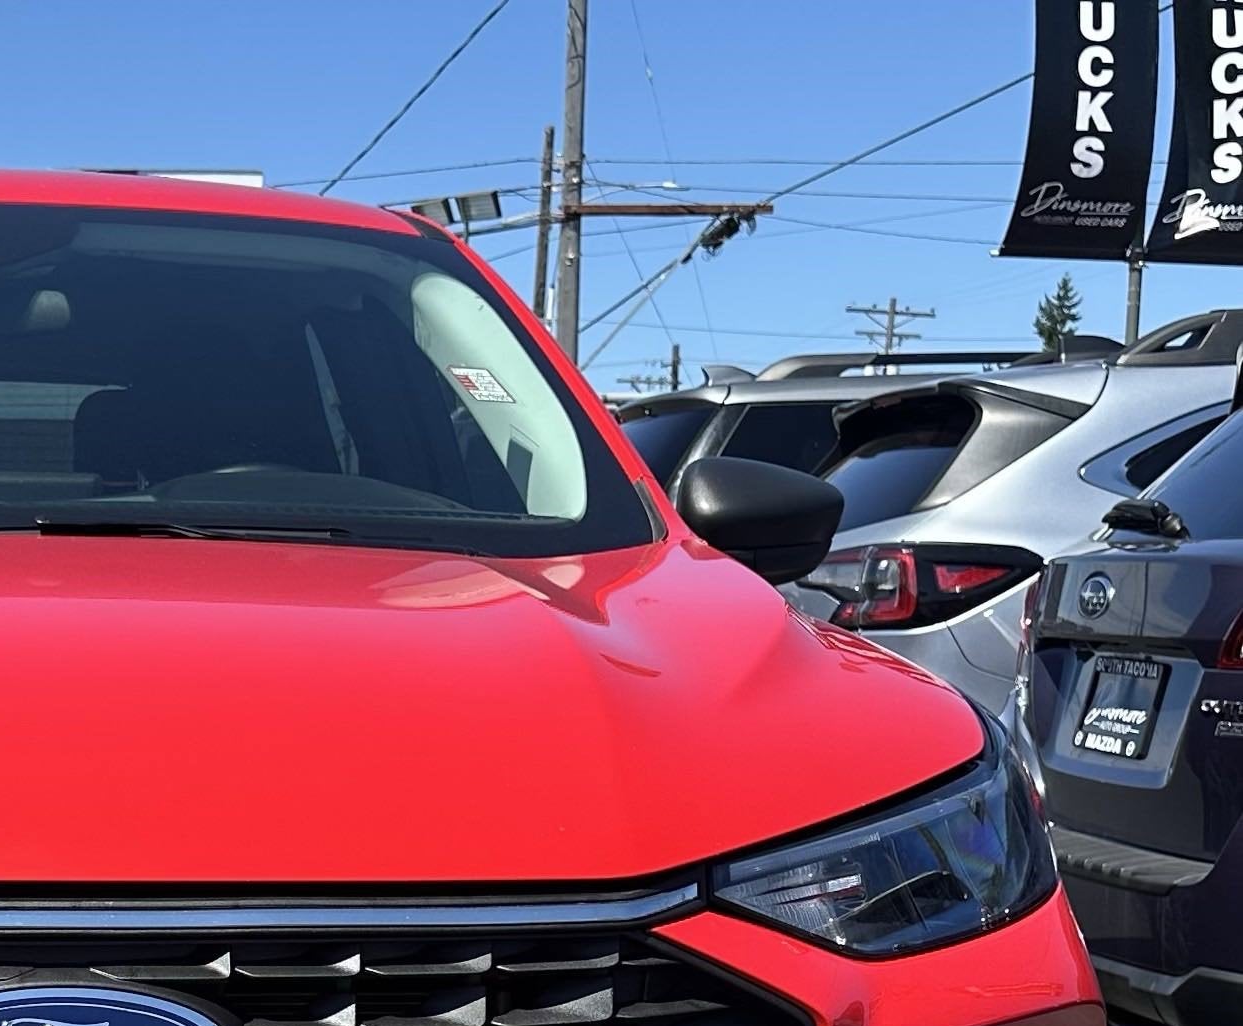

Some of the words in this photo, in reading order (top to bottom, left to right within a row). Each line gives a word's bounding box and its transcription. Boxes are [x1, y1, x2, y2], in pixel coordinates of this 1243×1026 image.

[1070, 1, 1115, 178] UCKS
[1210, 0, 1243, 183] UCKS
[1085, 733, 1122, 754] MAZDA
